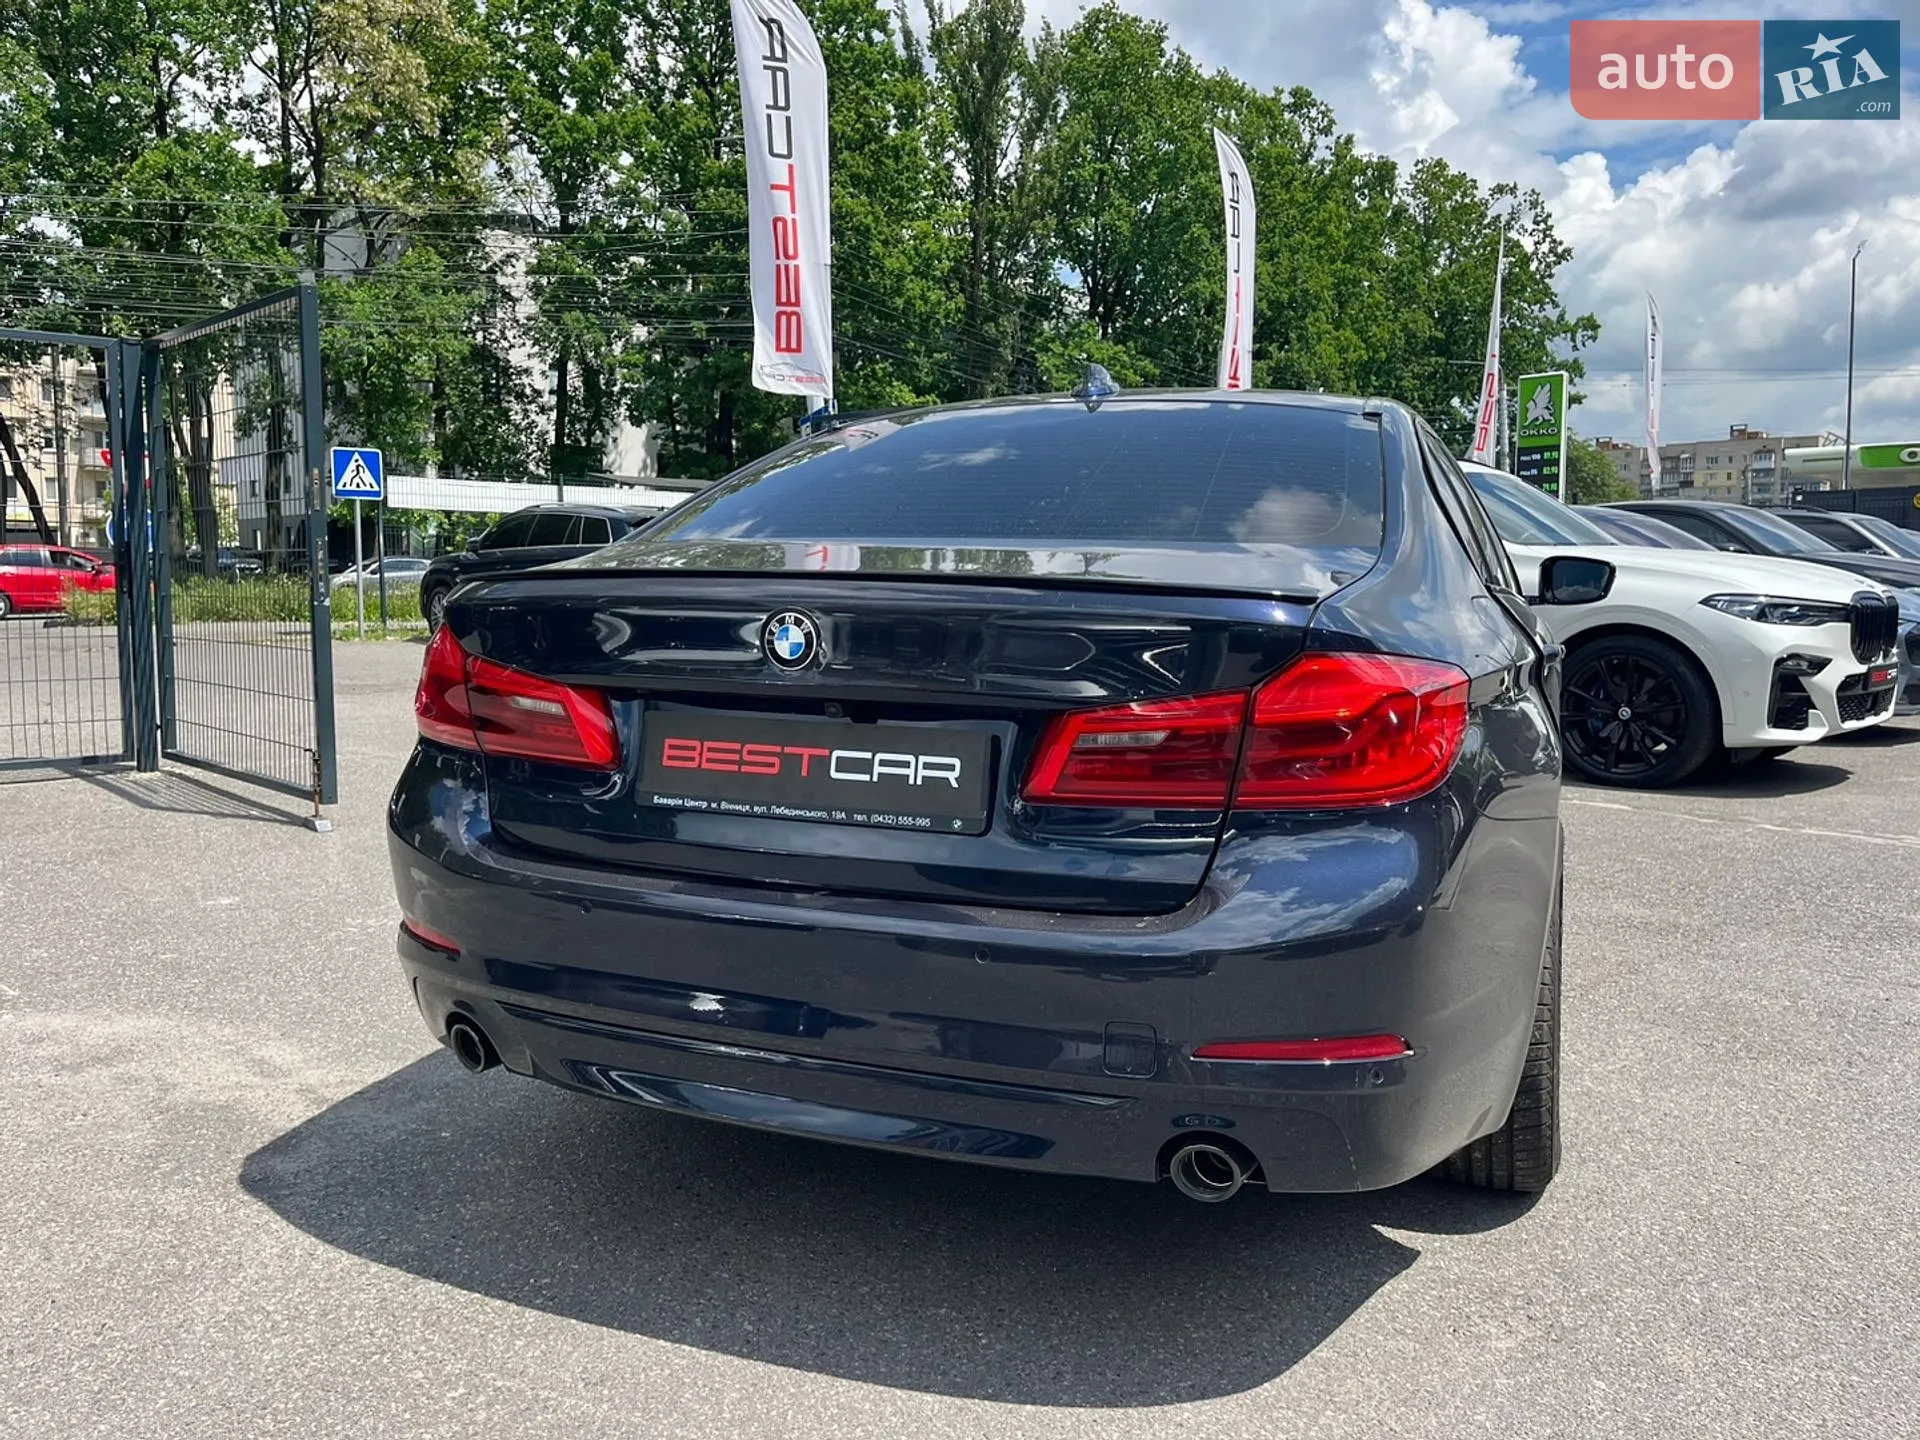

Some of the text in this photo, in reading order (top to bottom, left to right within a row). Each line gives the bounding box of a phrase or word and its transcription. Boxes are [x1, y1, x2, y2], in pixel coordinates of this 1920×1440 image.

[1520, 426, 1558, 436] OKKO
[662, 738, 961, 788] BESTCAR
[870, 814, 897, 826] (0432)
